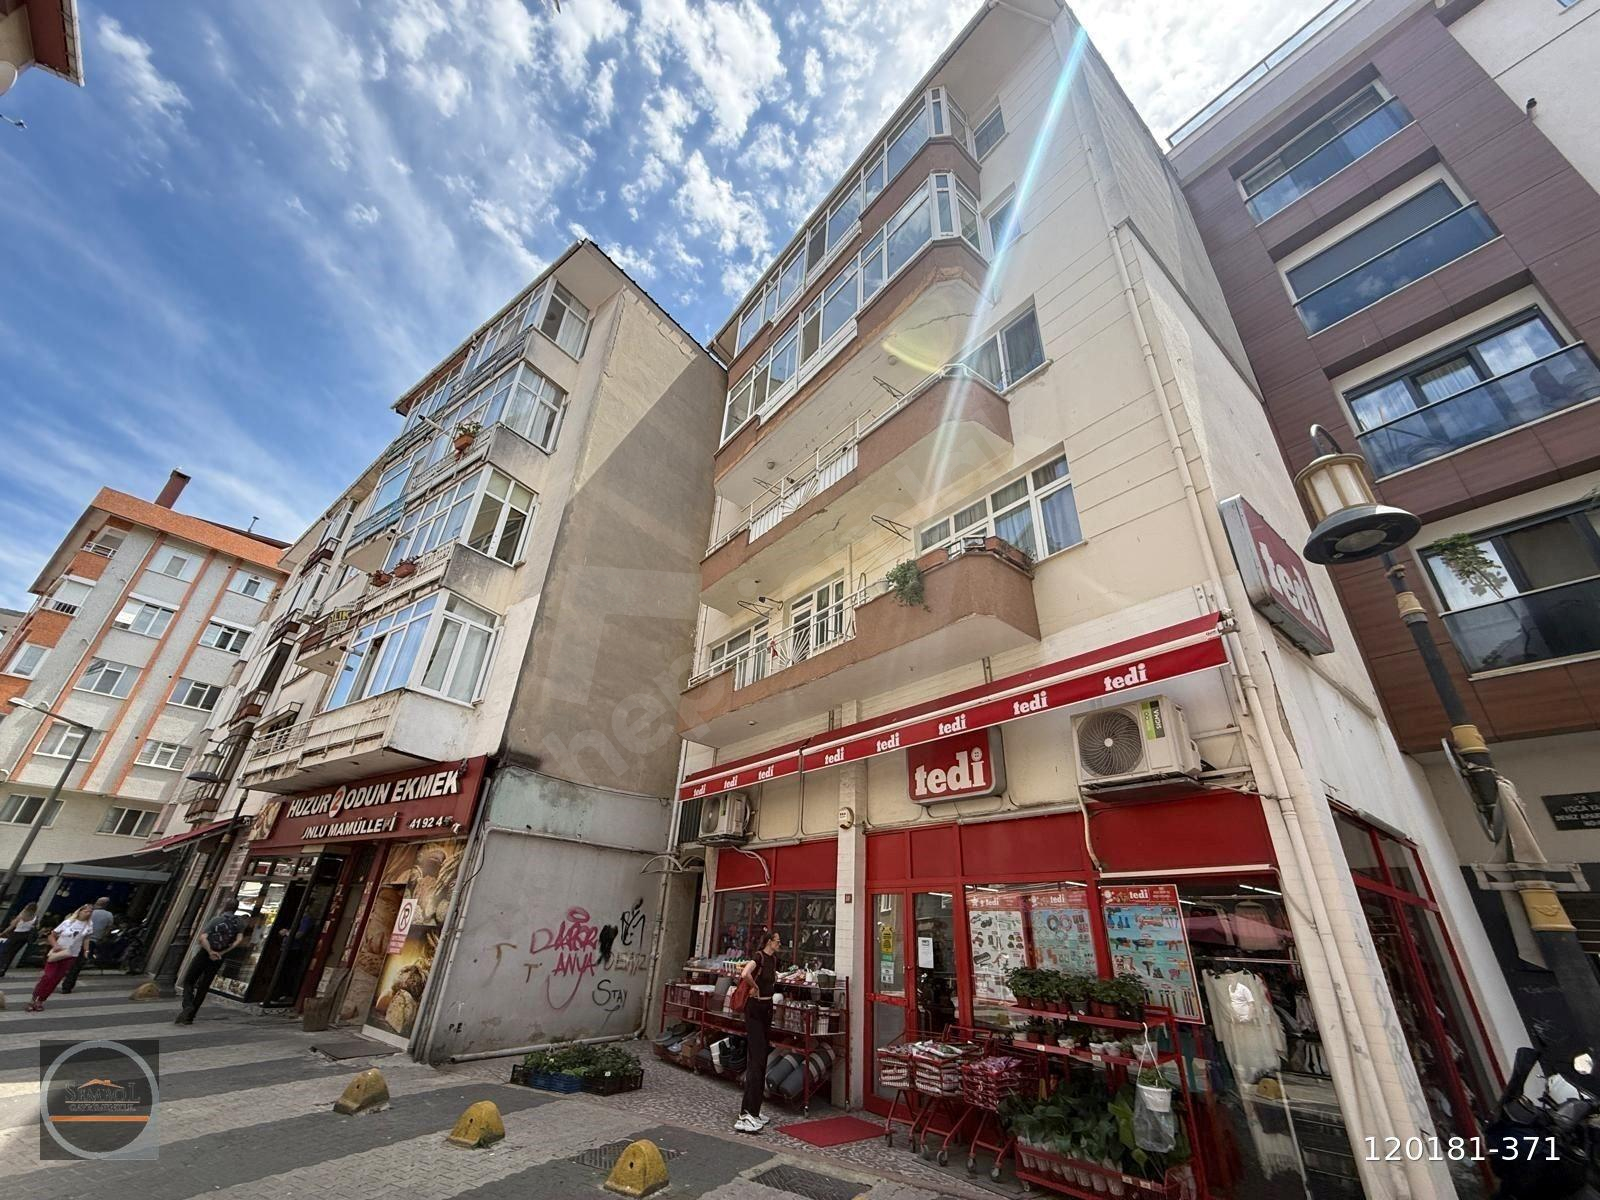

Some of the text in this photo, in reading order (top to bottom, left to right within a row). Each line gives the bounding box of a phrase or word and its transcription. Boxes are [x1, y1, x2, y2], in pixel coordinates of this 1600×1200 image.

[1259, 542, 1321, 630] tedi
[1103, 663, 1148, 692] tedi
[1013, 690, 1049, 716] tedi
[937, 713, 968, 736] tedi
[876, 731, 902, 753] tedi
[824, 746, 845, 765] tedi
[723, 775, 739, 789] tedi
[758, 765, 775, 781] tedi
[914, 747, 985, 796] tedi
[286, 793, 332, 819] HUZUR
[343, 782, 392, 811] ODUN
[392, 769, 460, 803] EKMEK
[693, 783, 706, 797] tedi
[1050, 893, 1065, 904] tedi
[1129, 889, 1149, 900] tedi
